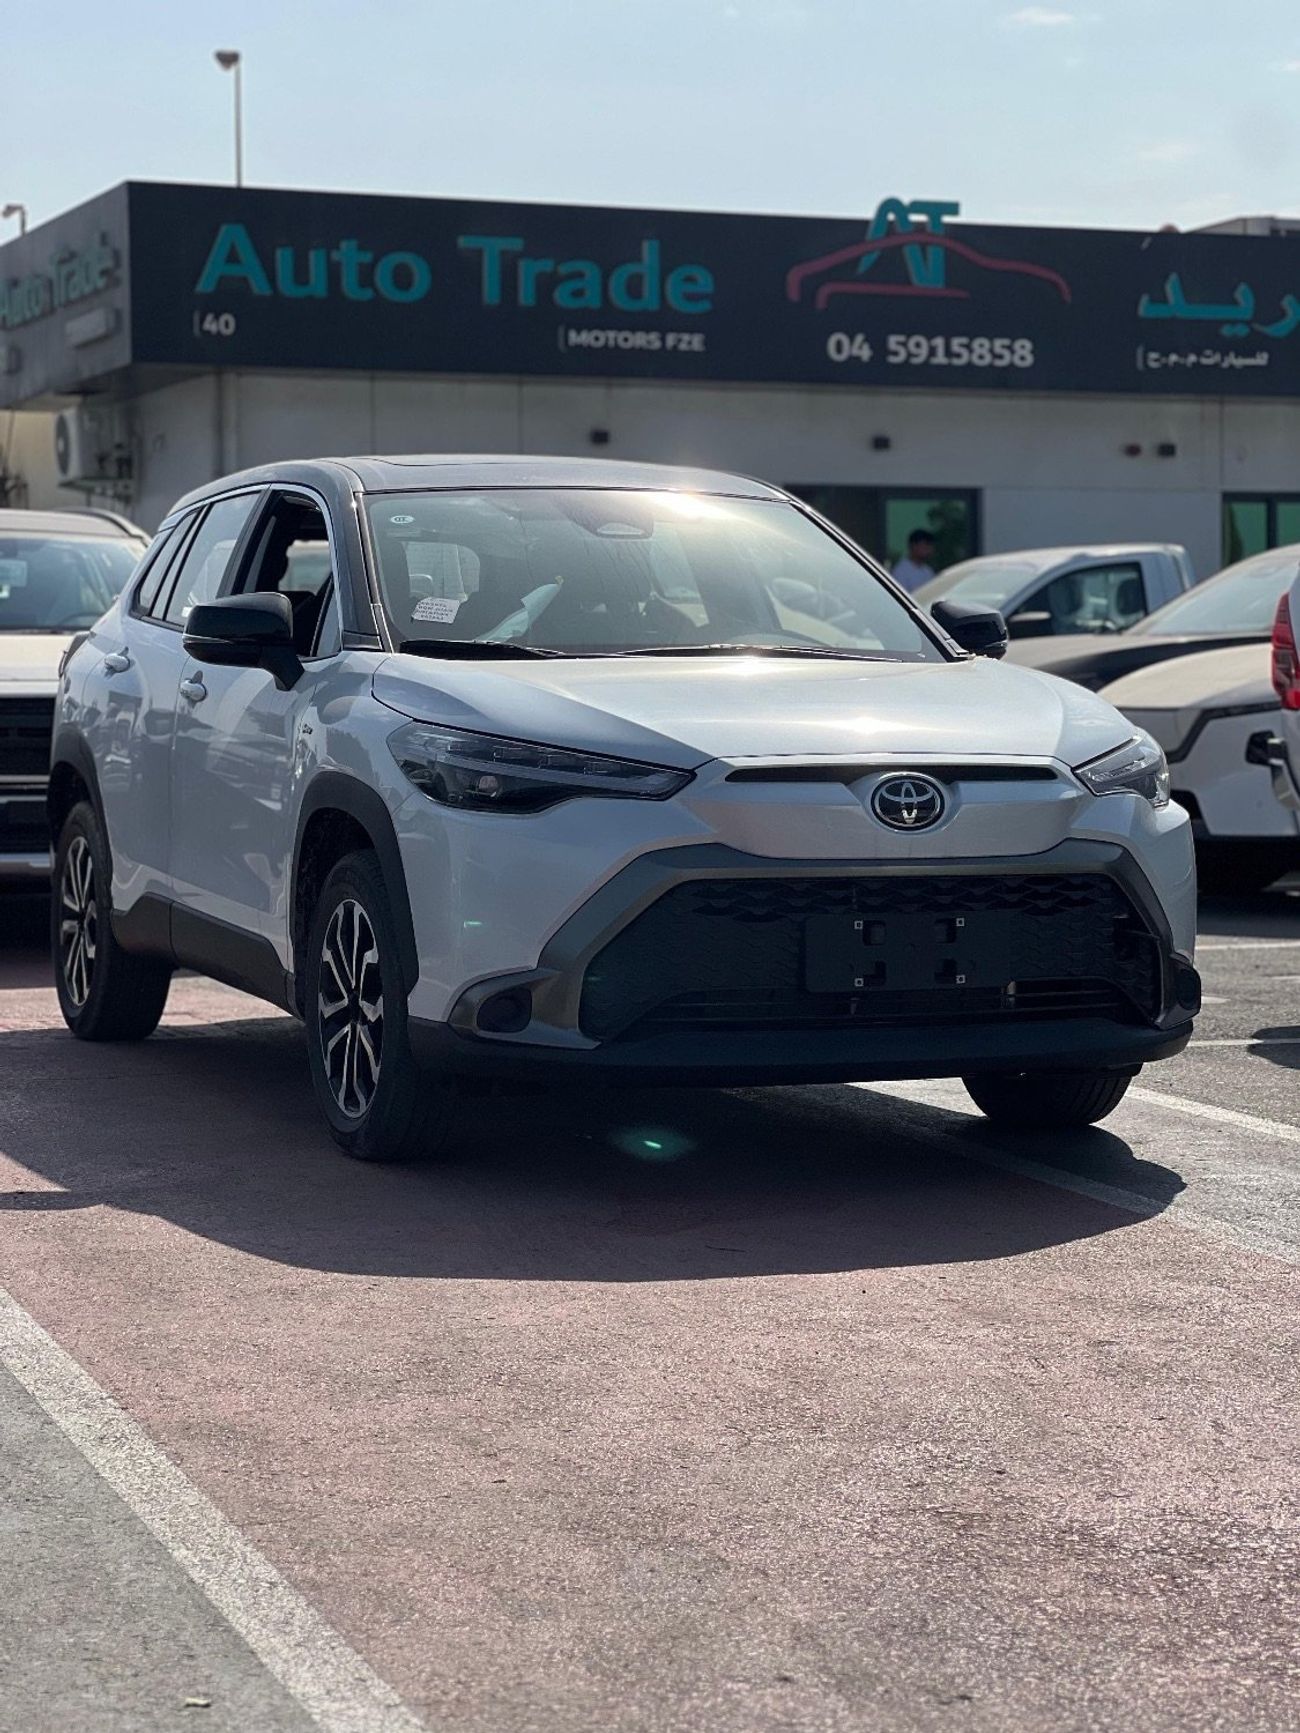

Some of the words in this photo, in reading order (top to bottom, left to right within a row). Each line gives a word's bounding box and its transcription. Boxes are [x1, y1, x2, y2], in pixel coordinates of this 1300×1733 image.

[195, 223, 431, 303] Auto
[457, 235, 715, 314] Trade
[202, 312, 236, 337] 40
[568, 329, 662, 351] MOTORS
[665, 332, 706, 352] FZE
[826, 332, 873, 363] 04
[886, 335, 1035, 368] 5915858
